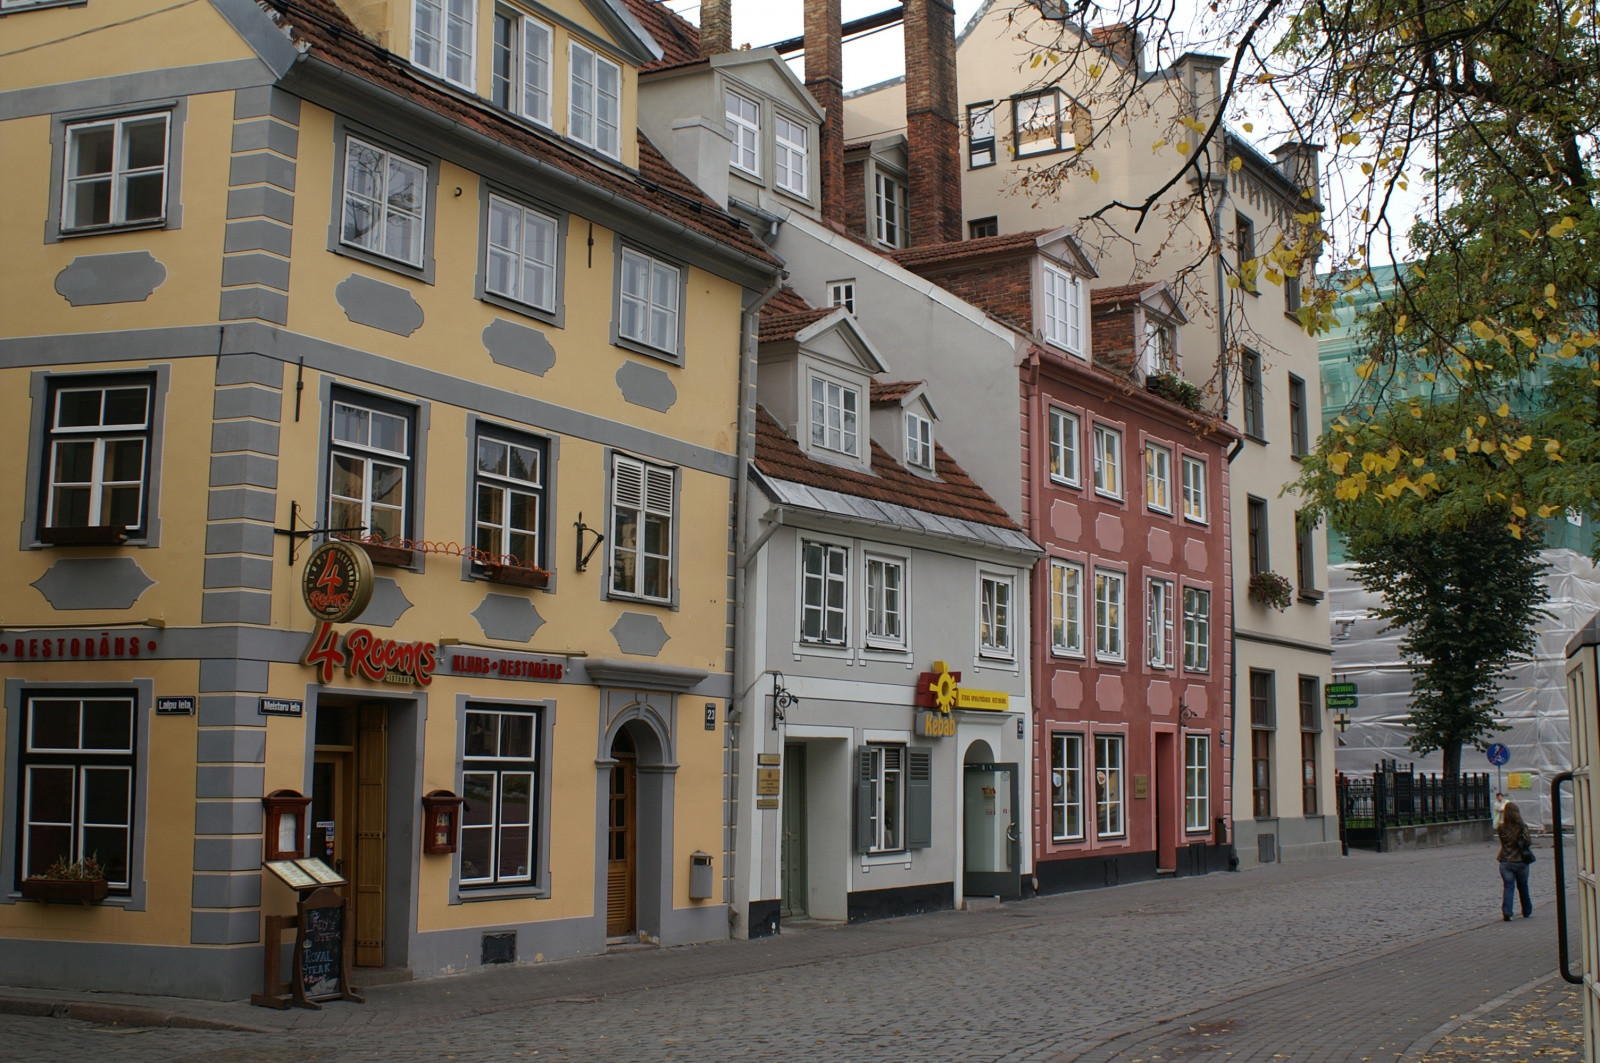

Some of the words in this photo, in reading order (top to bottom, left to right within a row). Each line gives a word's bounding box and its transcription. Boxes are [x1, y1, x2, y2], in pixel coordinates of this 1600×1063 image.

[316, 549, 343, 597] 4
[14, 632, 140, 658] RESTORĀNS
[305, 622, 346, 682] 4
[346, 628, 437, 687] Rooms
[452, 654, 490, 674] KLUBS
[498, 658, 563, 680] RESTORĀNS
[158, 699, 177, 712] Laipu
[178, 699, 191, 711] iela
[264, 700, 289, 712] Meistaru
[290, 702, 300, 712] iela
[707, 708, 715, 720] 23
[924, 713, 956, 737] Kebab
